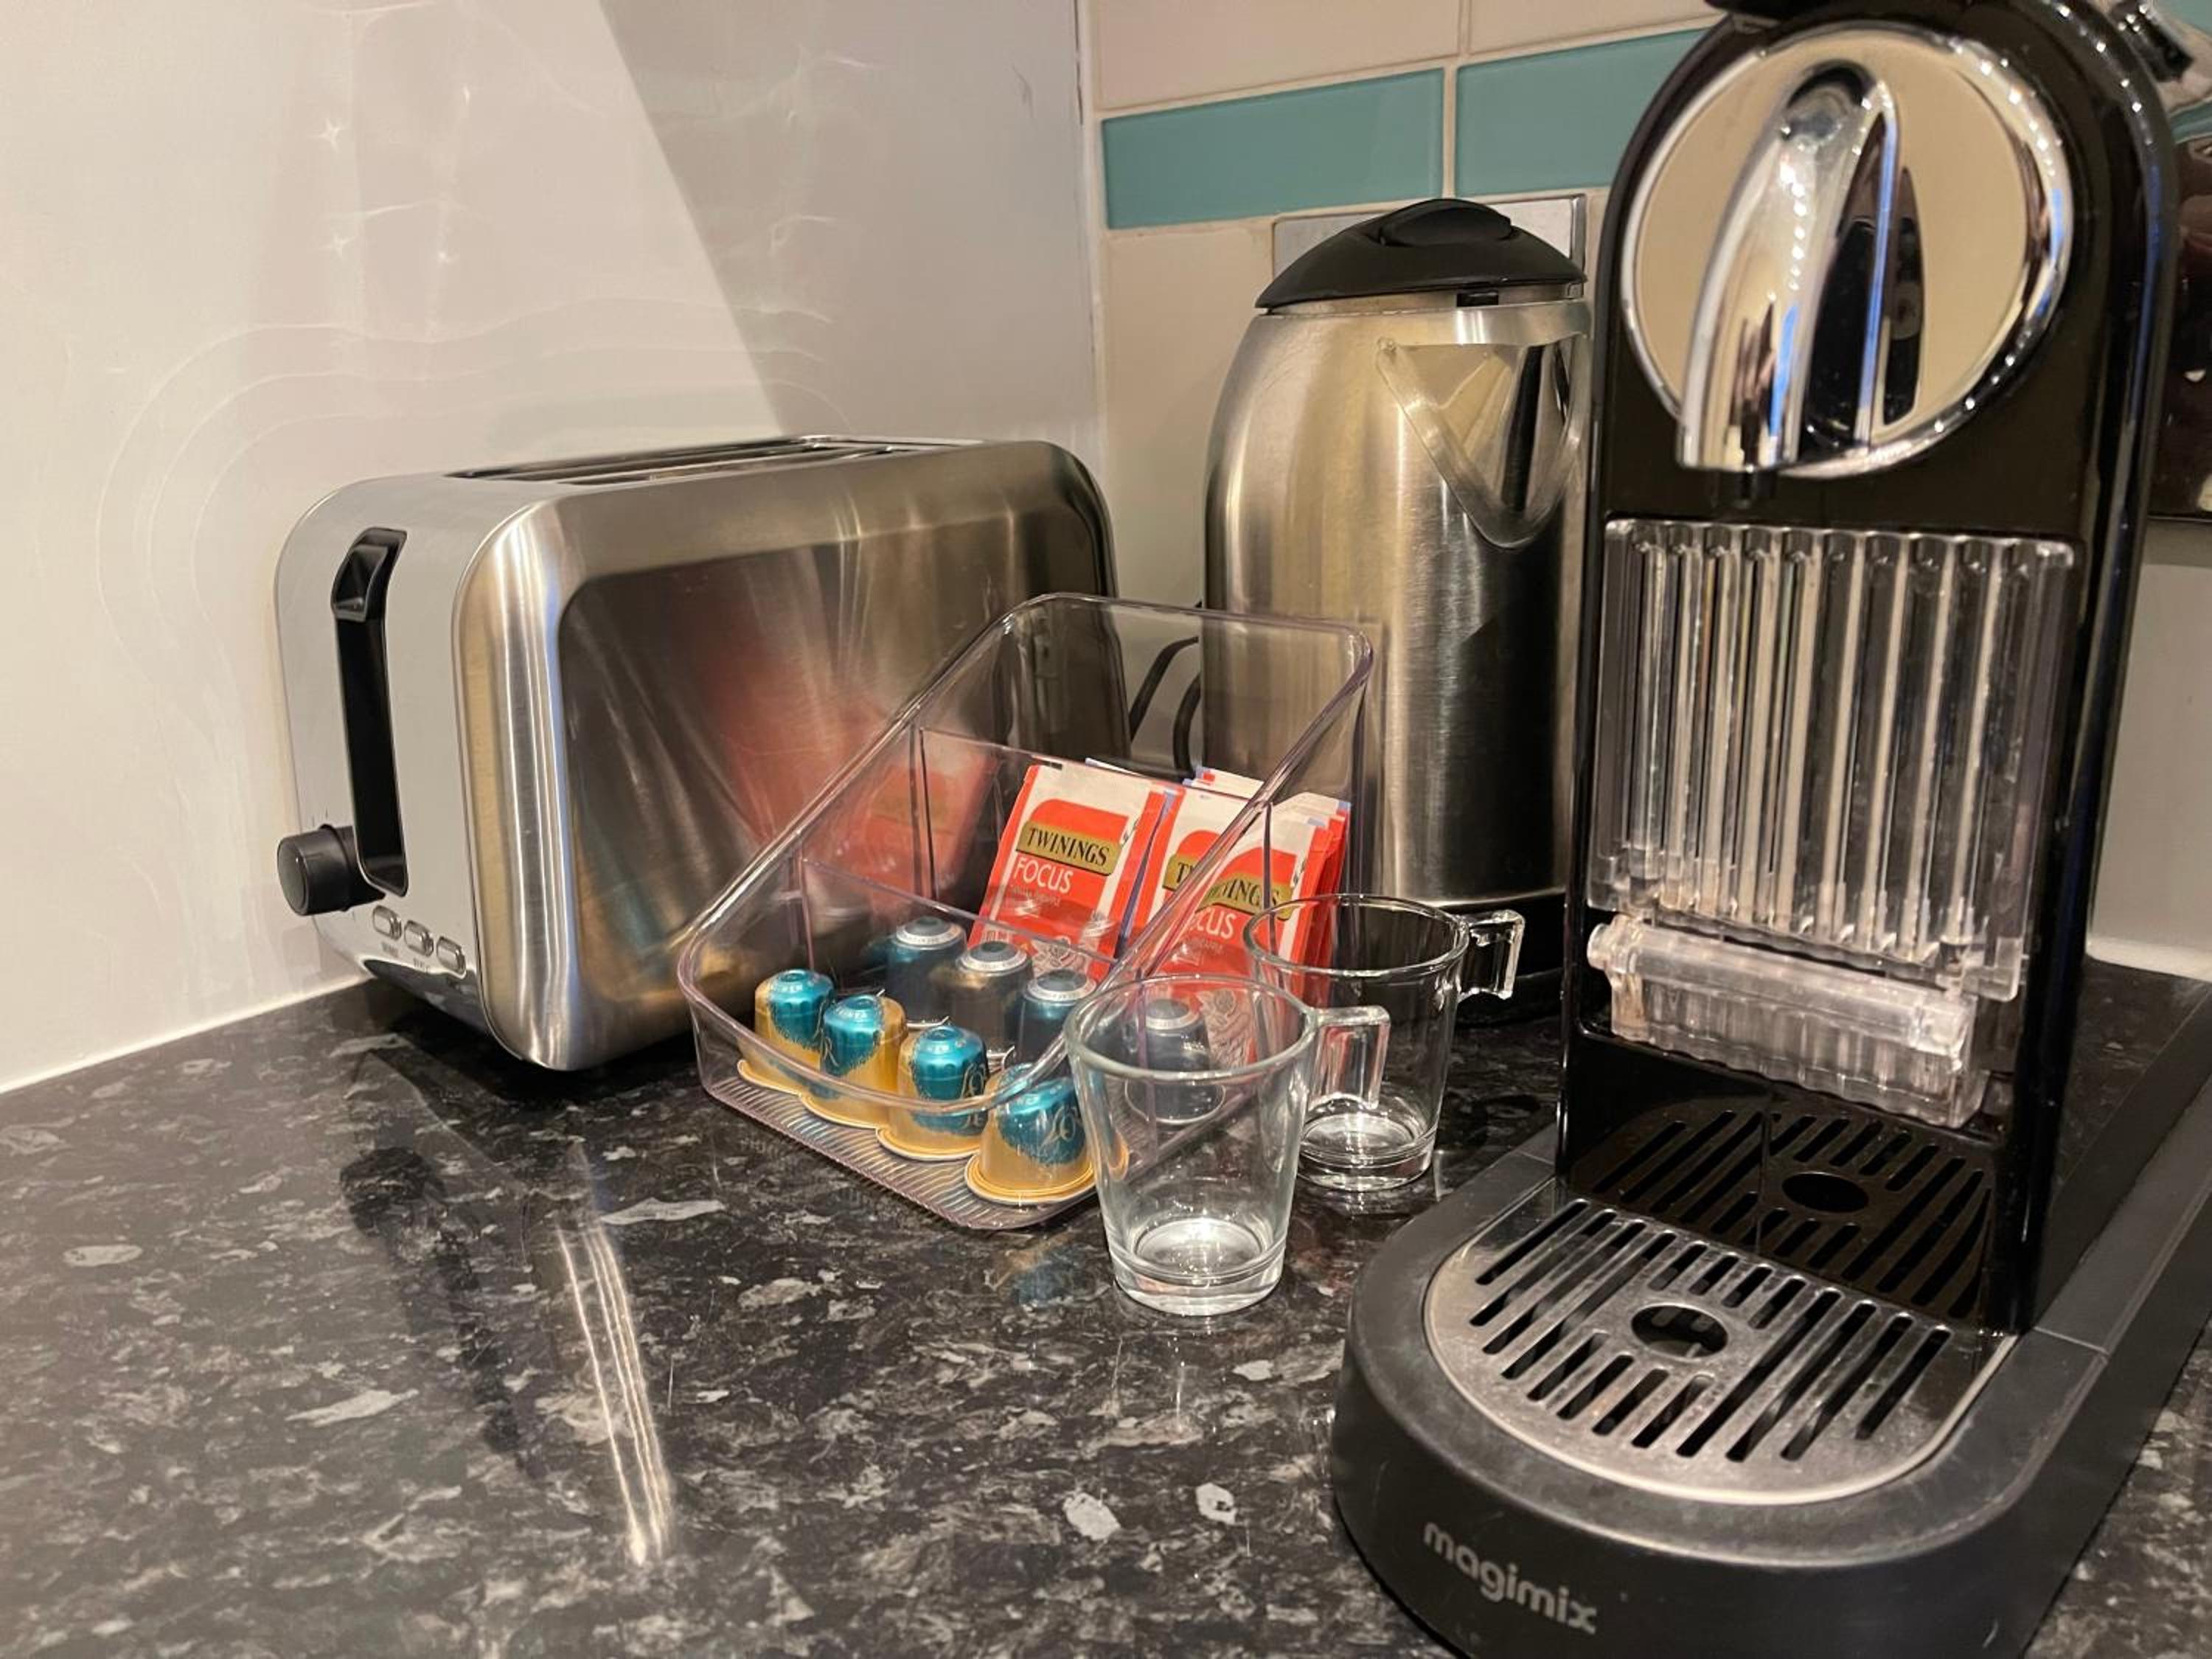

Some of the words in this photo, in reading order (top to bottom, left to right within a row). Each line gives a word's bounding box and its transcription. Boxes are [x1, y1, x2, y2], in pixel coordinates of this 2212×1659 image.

[1027, 827, 1110, 866] TWININGS
[1013, 856, 1074, 894] FOCUS
[1190, 907, 1237, 939] CUS
[1422, 1522, 1598, 1635] magimix
